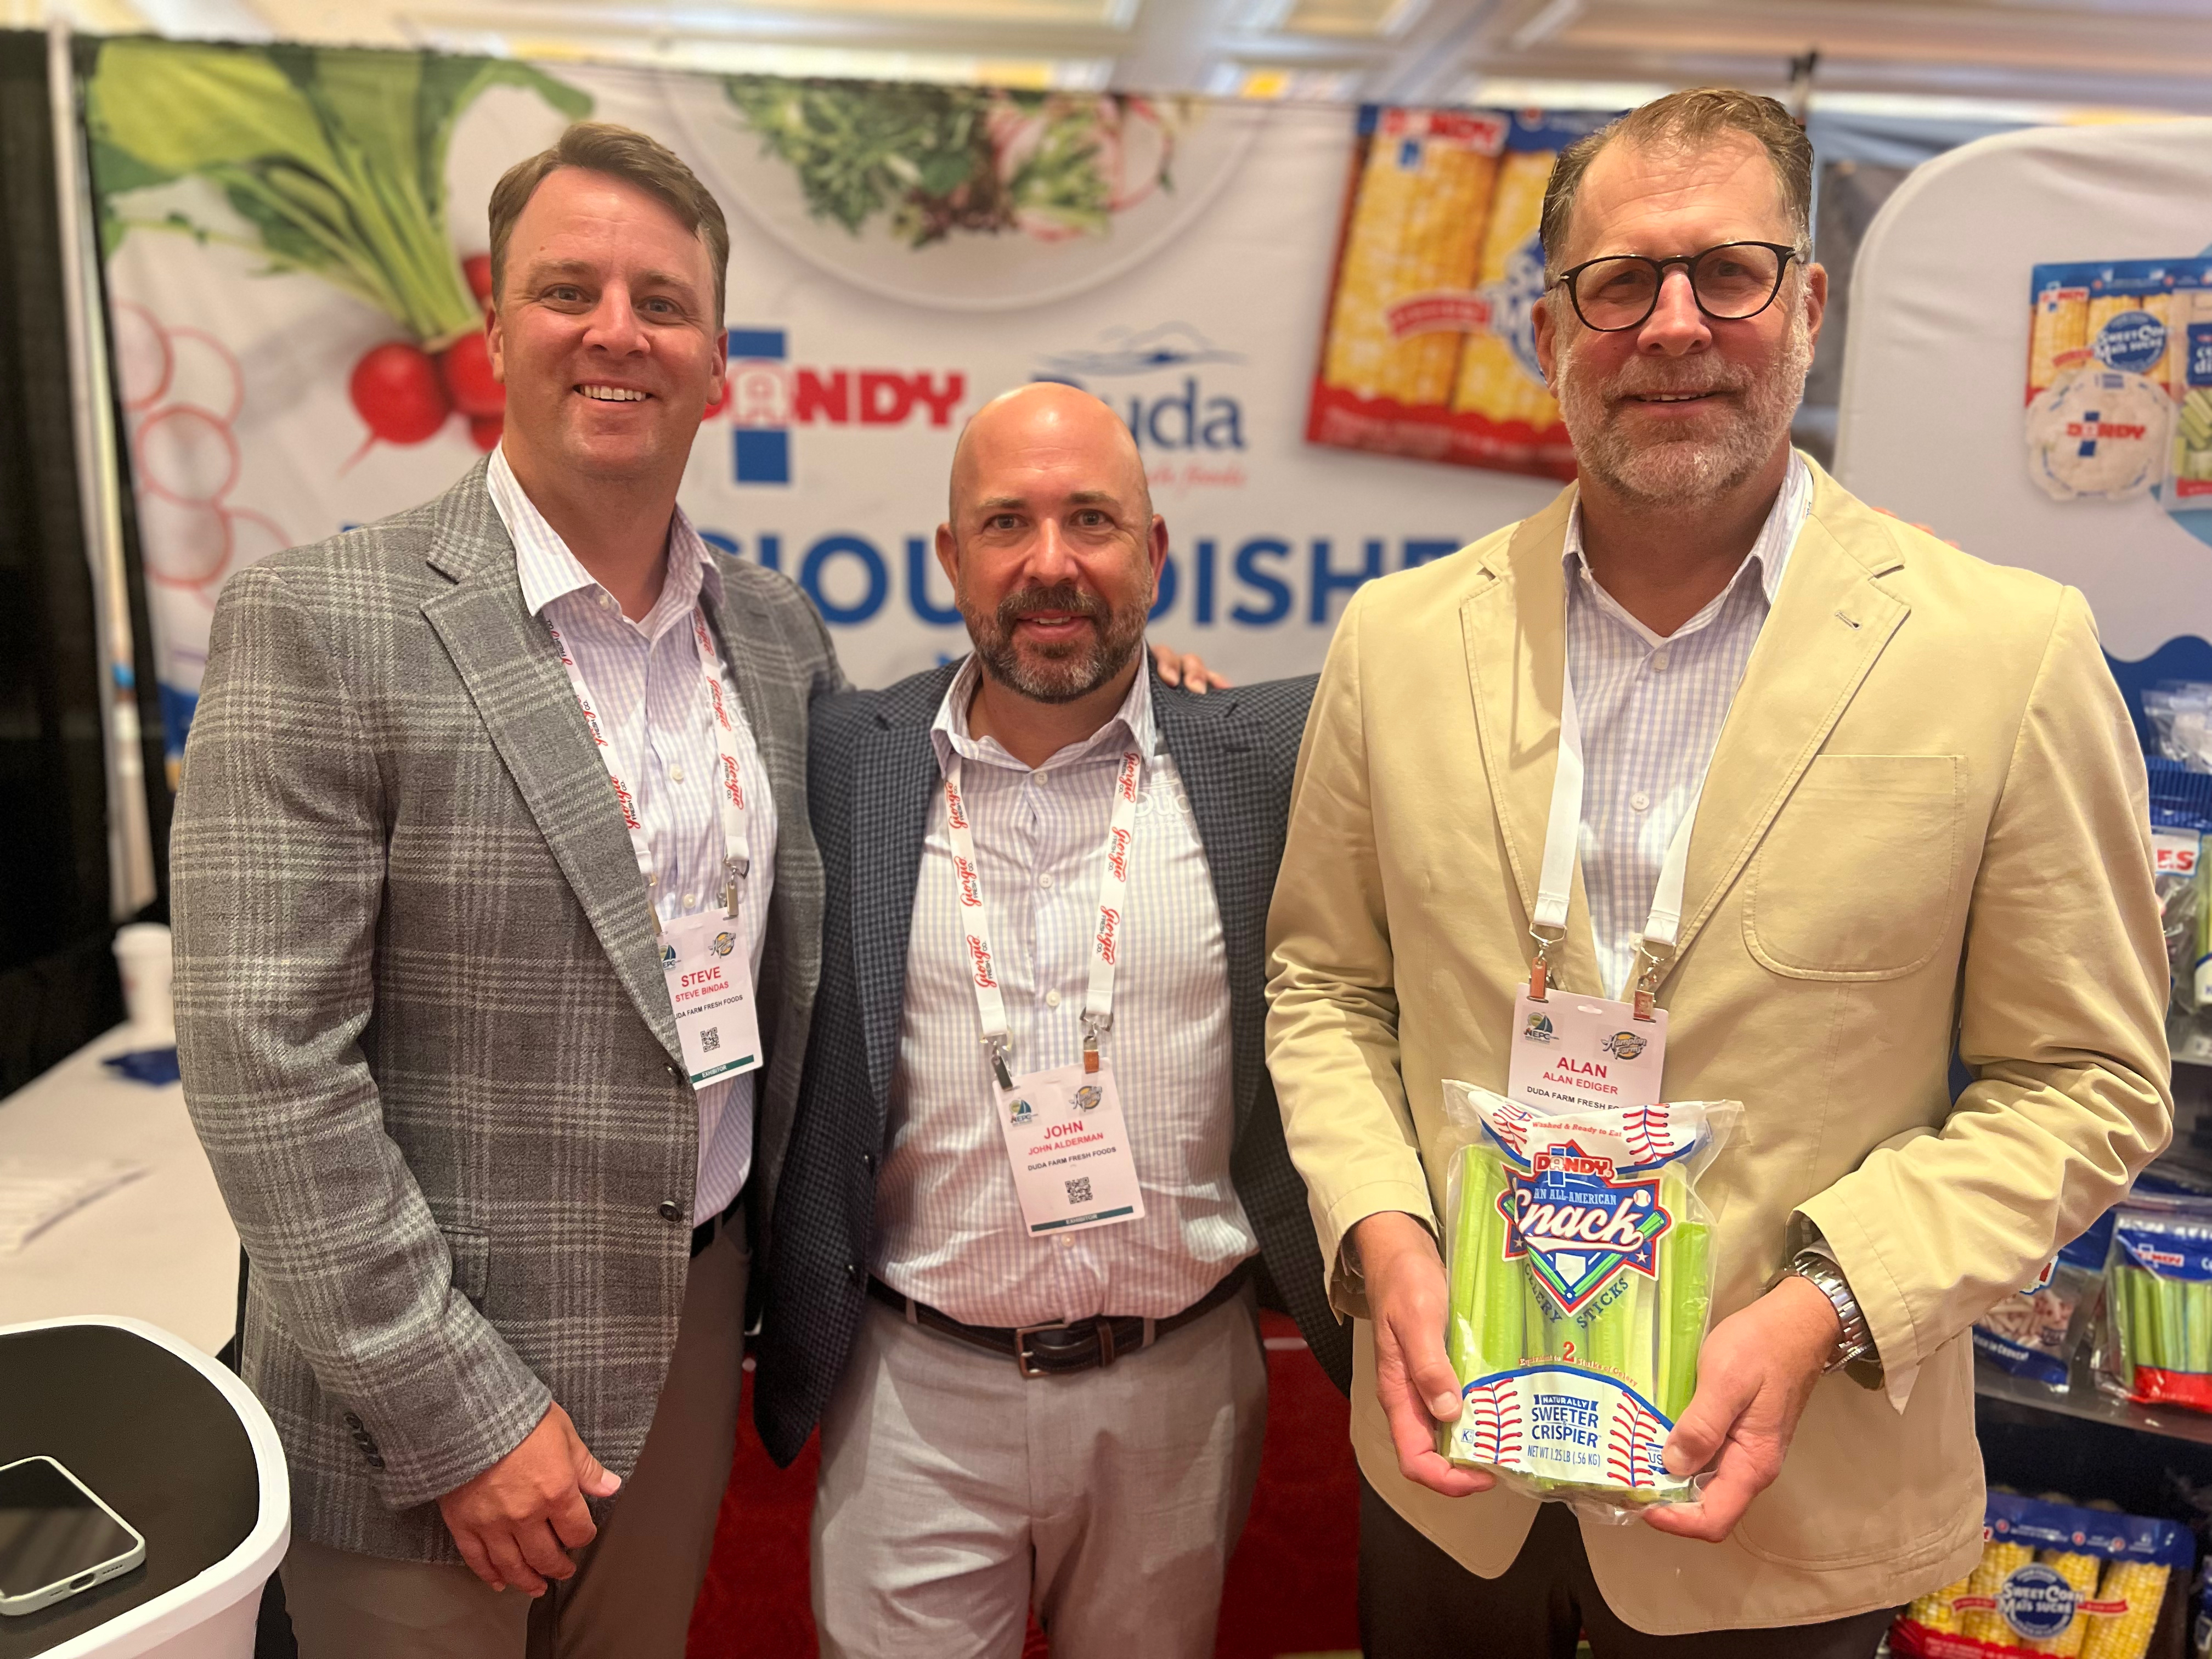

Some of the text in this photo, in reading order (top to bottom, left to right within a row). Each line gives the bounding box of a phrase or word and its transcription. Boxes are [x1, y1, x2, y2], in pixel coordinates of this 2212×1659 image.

[721, 753, 743, 810] Giorgio
[1119, 752, 1139, 803] Giorgio
[945, 780, 968, 829] Giorgio
[1108, 826, 1131, 882] Giorgio
[953, 856, 982, 906] Giorgio
[1097, 905, 1120, 965] Giorgio
[967, 935, 997, 988] Giorgio
[681, 967, 721, 988] STEVE
[676, 981, 729, 1002] STEVE BINDAS
[687, 1006, 703, 1015] FARM
[704, 1001, 722, 1011] FRESH
[724, 995, 743, 1005] FOODS
[702, 1065, 727, 1077] EXHIBITOR
[1556, 1057, 1607, 1078] ALAN
[1543, 1071, 1618, 1094] ALAN EDIGER
[1527, 1086, 1549, 1097] DUDA
[1552, 1092, 1575, 1103] FARM
[1577, 1098, 1605, 1109] FRESH
[1044, 1120, 1083, 1139] JOHN
[1572, 1124, 1598, 1134] Ready
[1028, 1133, 1103, 1155] JOHN ALDERMAN
[1028, 1147, 1116, 1171] DUDA FARM FRESH FOODS
[1537, 1156, 1608, 1175] DANDY
[1533, 1188, 1616, 1205] AN ALL-AMERICAN
[1525, 1263, 1628, 1328] CELERY STICKS
[1563, 1341, 1576, 1363] 2
[1543, 1397, 1587, 1408] NATURALLY
[1532, 1407, 1599, 1428] SWEETER
[1532, 1425, 1598, 1448] CRISPIER
[1527, 1445, 1600, 1467] NET WT 1.25 LB (.56 KG)
